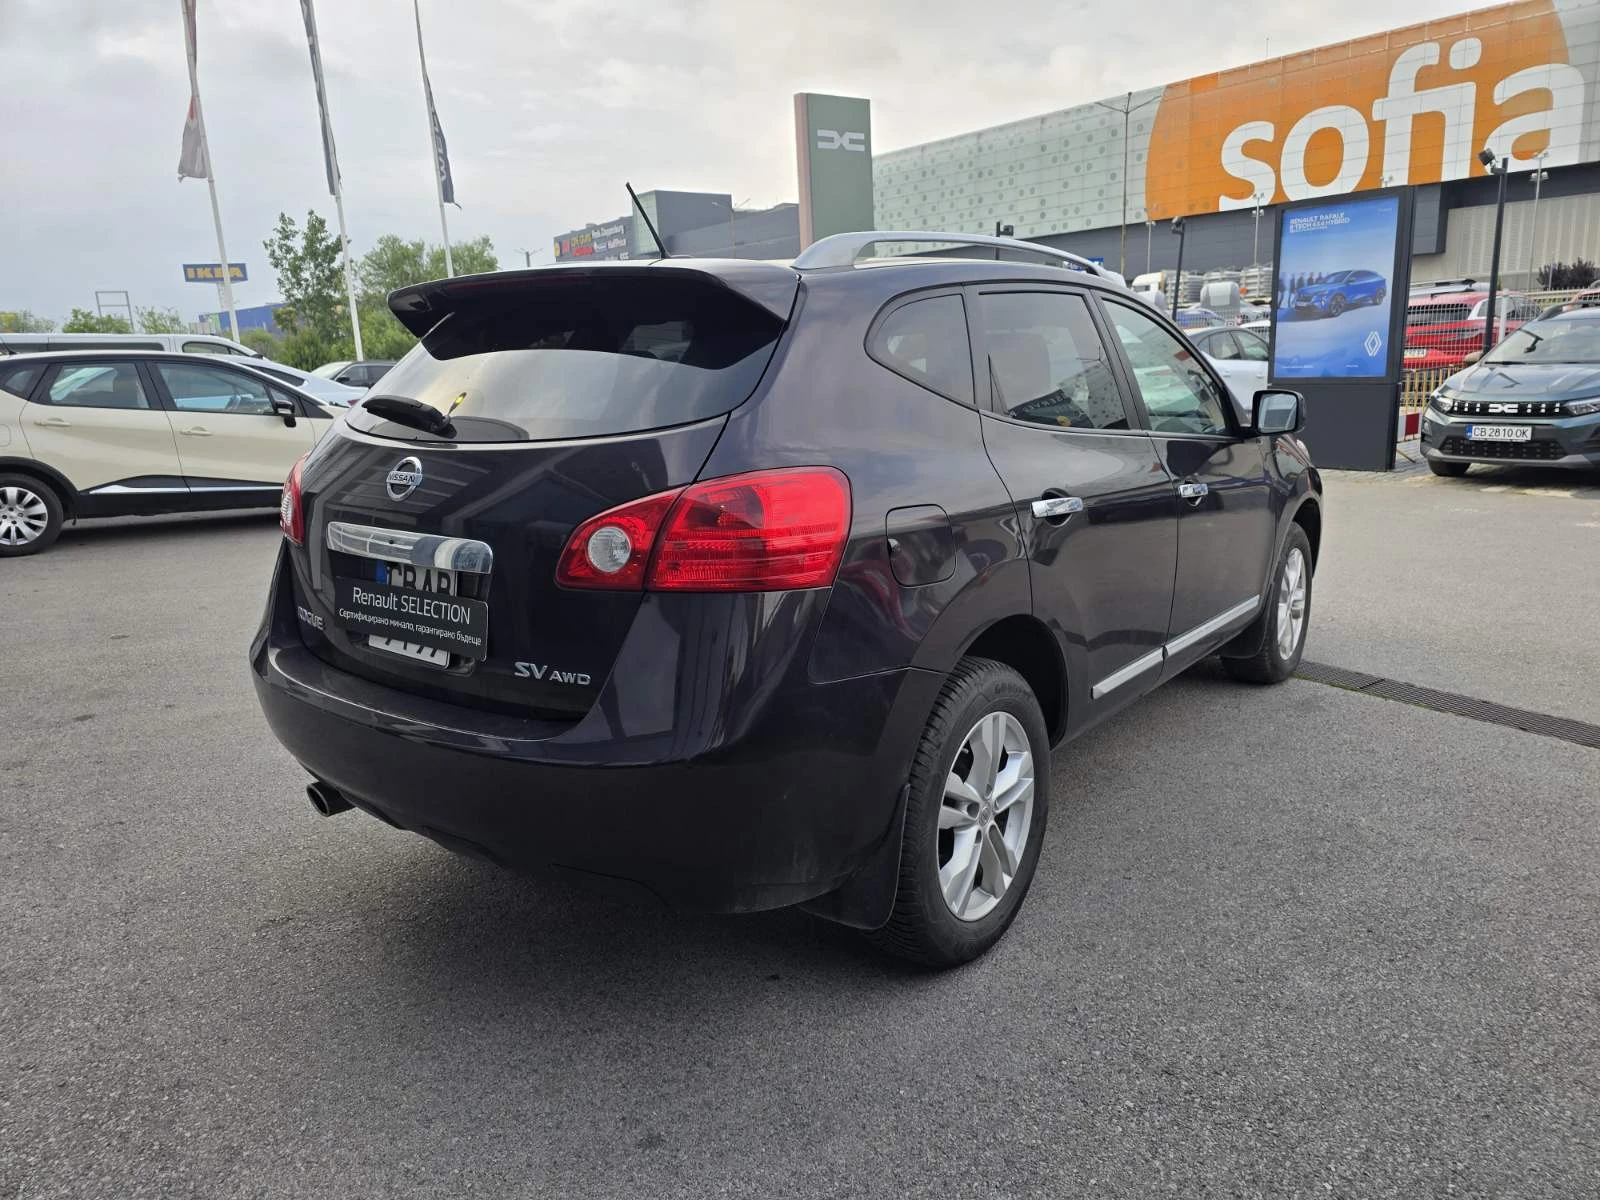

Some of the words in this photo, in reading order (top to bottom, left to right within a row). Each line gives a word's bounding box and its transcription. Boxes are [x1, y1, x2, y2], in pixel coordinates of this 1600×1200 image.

[1219, 37, 1585, 211] sofia
[186, 267, 244, 279] IKEA
[1473, 427, 1487, 438] CB
[1488, 428, 1514, 438] 2810
[1515, 428, 1529, 439] OK
[389, 472, 416, 484] NISSAN
[352, 586, 398, 611] Renault
[400, 594, 471, 625] SELECTION
[338, 607, 389, 626] Сертифицирано
[389, 617, 415, 632] минало,
[415, 623, 456, 640] гарантирано
[456, 630, 482, 647] бъдеще
[514, 661, 548, 680] SV
[549, 670, 591, 685] AWD
